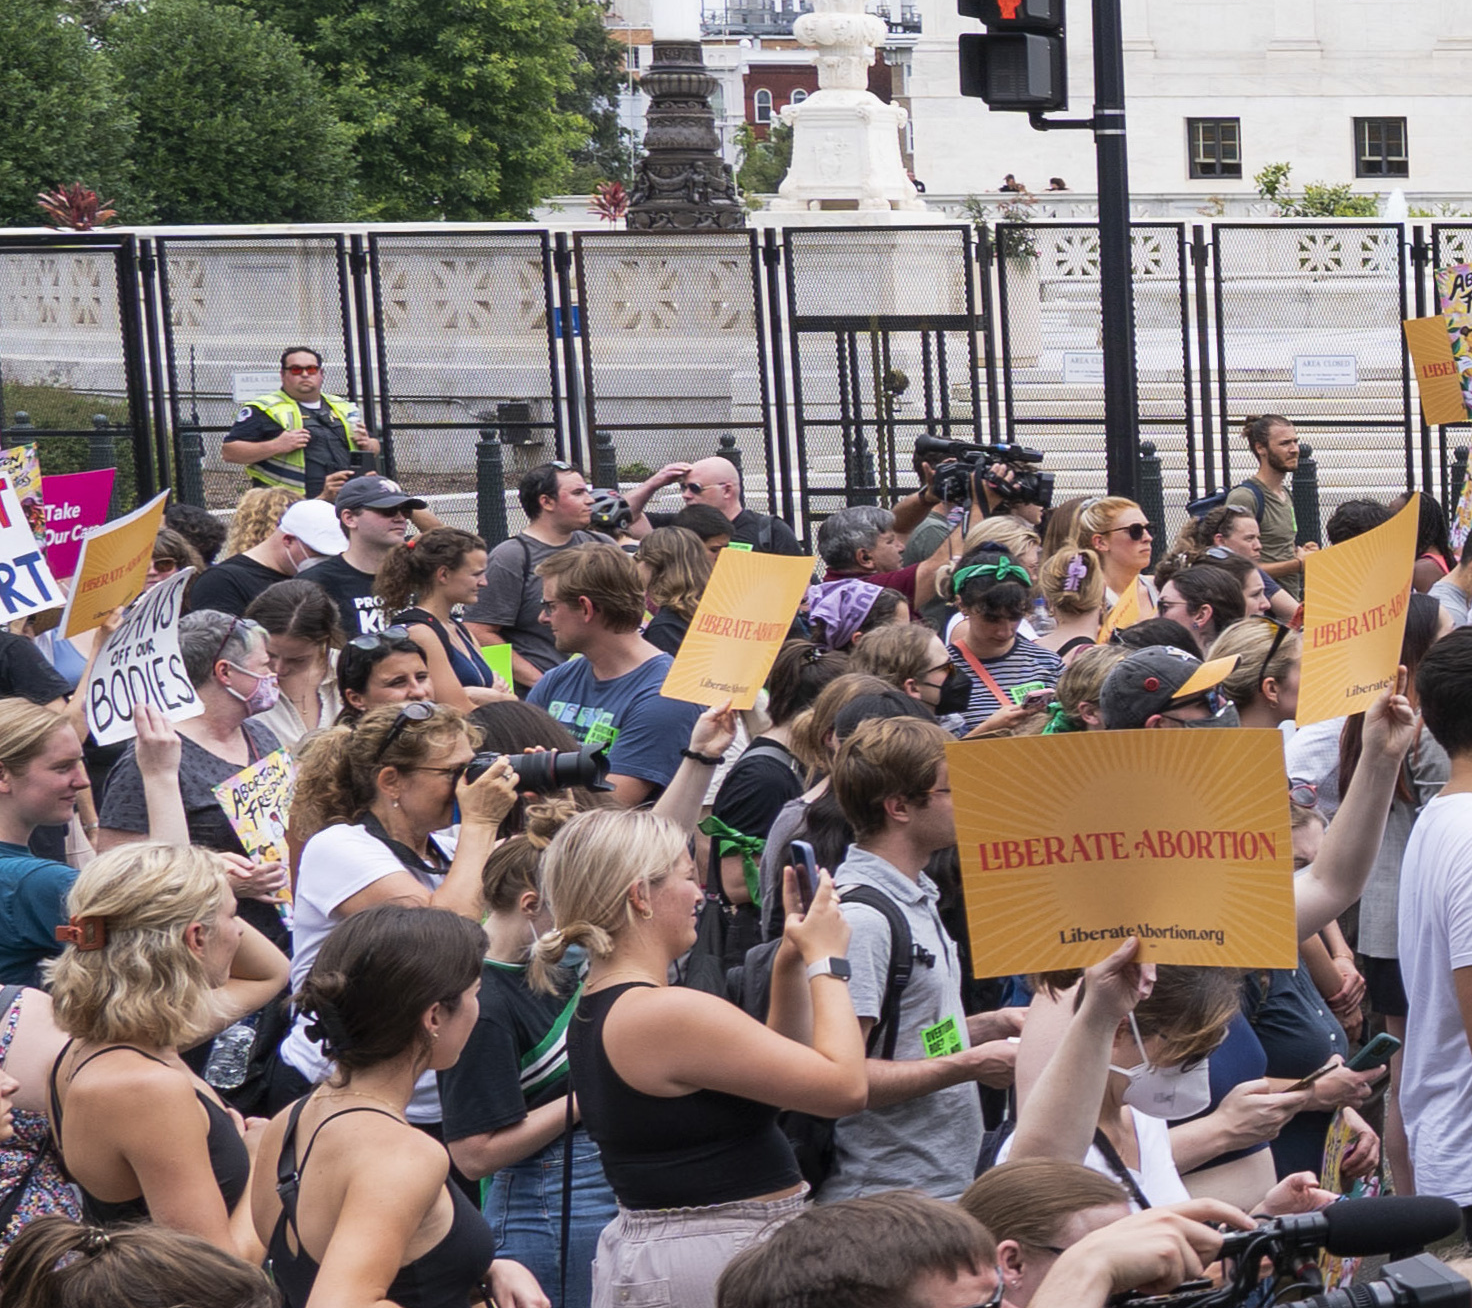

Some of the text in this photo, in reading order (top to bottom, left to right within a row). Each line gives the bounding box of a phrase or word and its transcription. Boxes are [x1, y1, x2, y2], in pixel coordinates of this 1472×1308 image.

[1302, 358, 1351, 367] AREA CLOSED
[45, 501, 81, 521] Take
[697, 612, 754, 640] LIBERATE
[1312, 604, 1388, 650] LIBERATE
[110, 638, 156, 667] OFF OUR
[90, 653, 195, 733] BODIES
[977, 828, 1278, 873] LIBERATE ABORTION
[1059, 923, 1226, 946] LiberateAbortion.org
